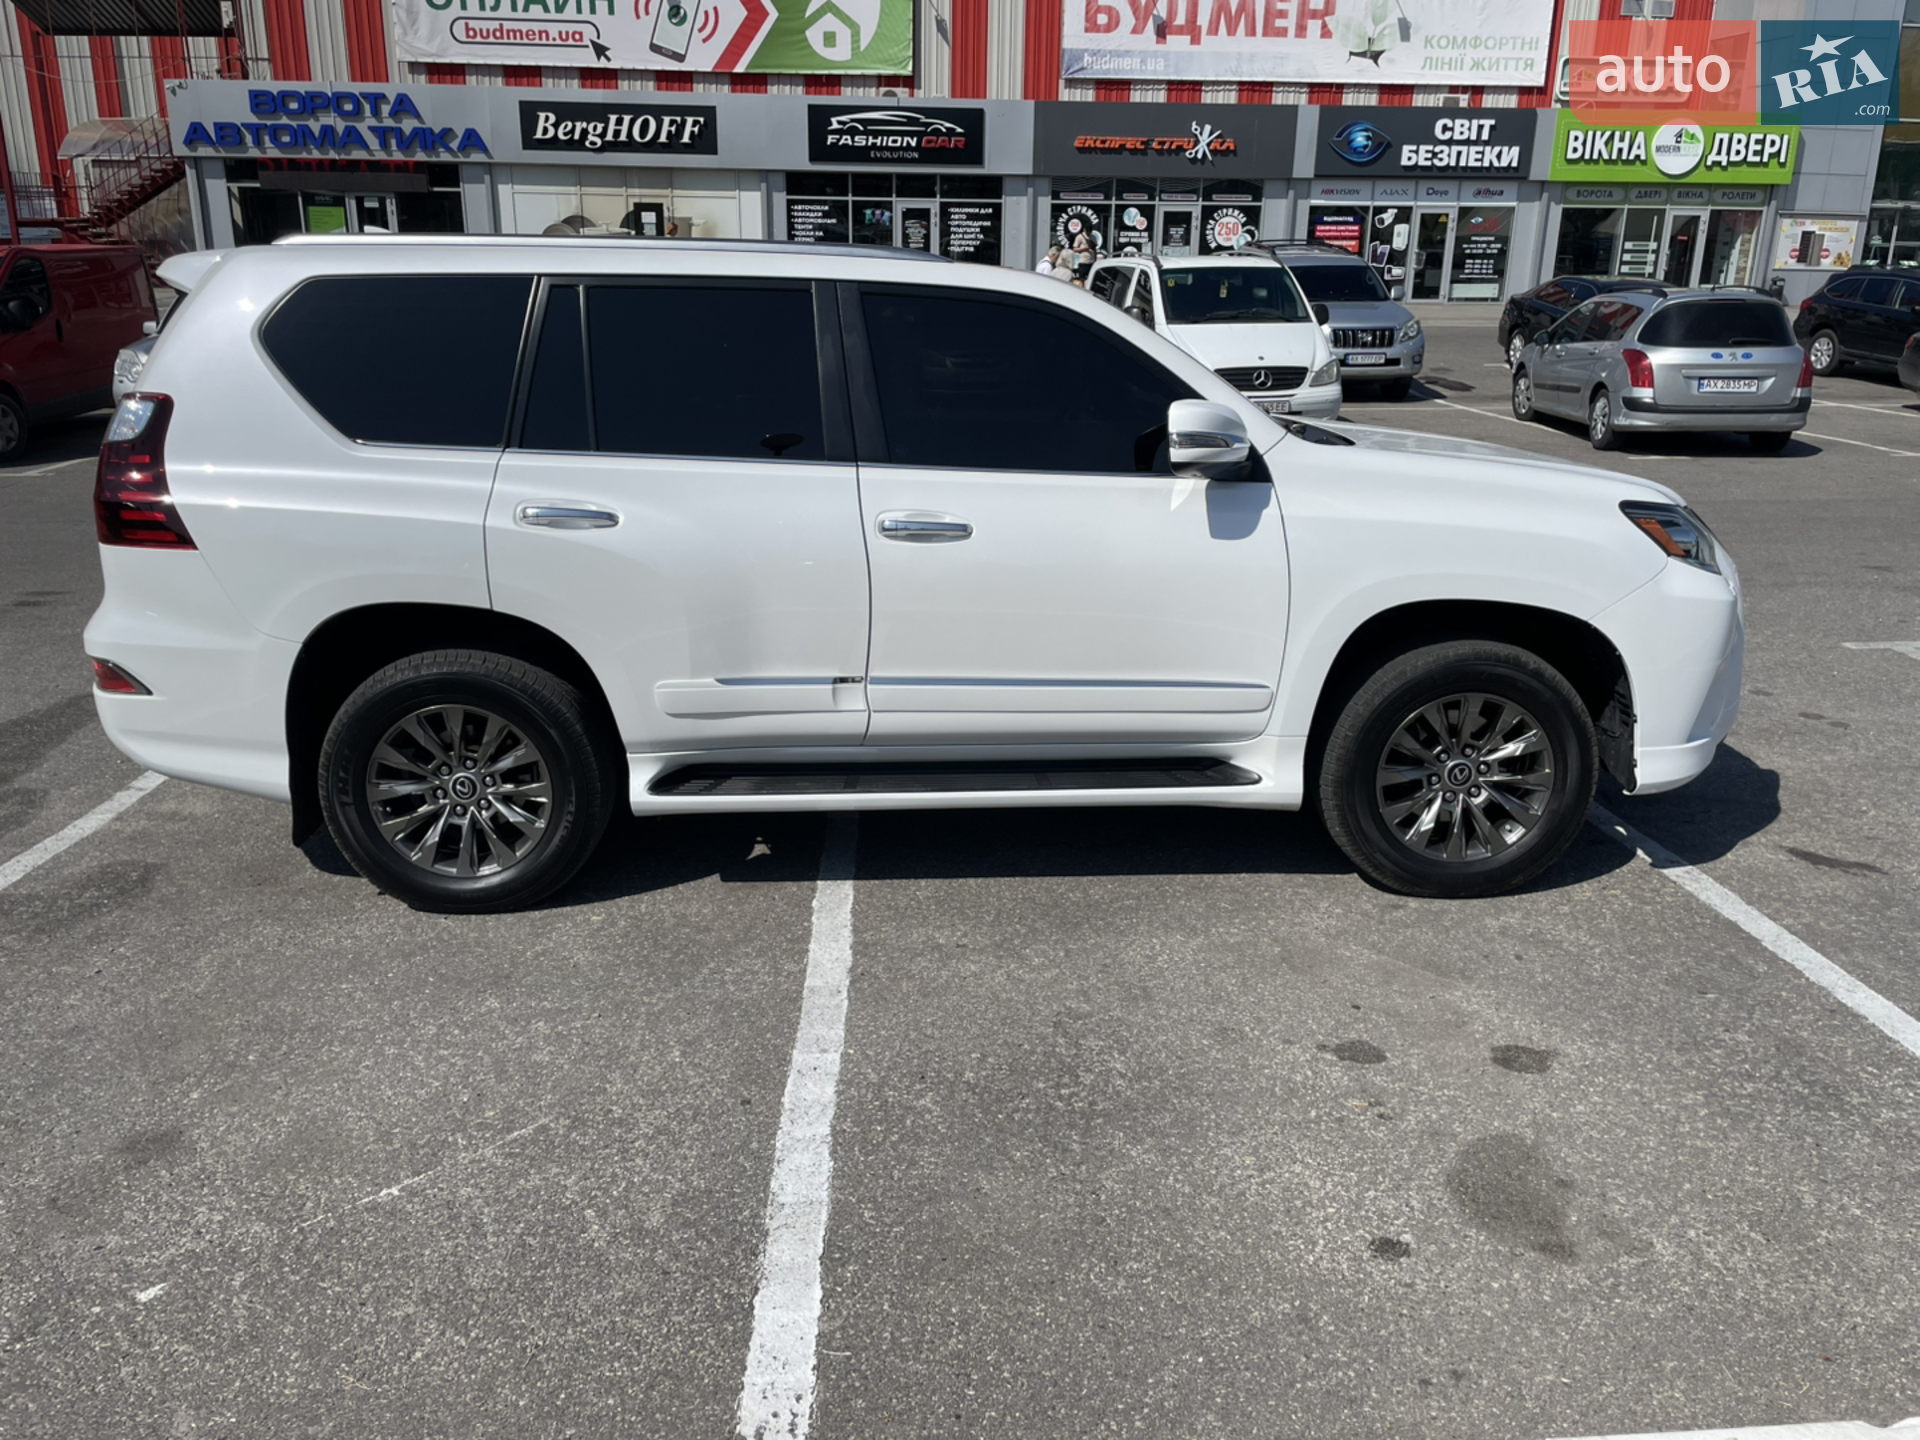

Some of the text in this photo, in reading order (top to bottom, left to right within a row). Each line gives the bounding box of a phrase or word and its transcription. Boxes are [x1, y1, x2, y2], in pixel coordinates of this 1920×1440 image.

[464, 21, 584, 43] budmen.ua
[1423, 34, 1540, 51] КОМФОРТНІ
[1083, 53, 1165, 71] budmen.ua
[1420, 53, 1535, 72] ЛІНІЇ ЖИТТЯ
[248, 89, 421, 118] ВОРОТА
[182, 121, 489, 153] АВТОМАТИКА
[532, 111, 705, 149] BergHOFF
[1434, 117, 1496, 141] СВІТ
[826, 134, 967, 149] FASHION CAR
[1074, 135, 1148, 149] ЕКСПРЕС
[1565, 129, 1790, 167] ВІКНА ДВЕРІ
[870, 150, 920, 159] EVOLUTION
[1400, 144, 1521, 168] БЕЗПЕКИ
[1320, 188, 1362, 196] HIKVISION
[1575, 188, 1614, 199] ВОРОТА
[1634, 189, 1662, 200] ДВЕРІ
[1676, 190, 1704, 200] ВІКНА
[1721, 191, 1757, 201] РОЛЕТИ
[1217, 221, 1241, 237] 250
[1704, 379, 1757, 390] AX 2835 MP
